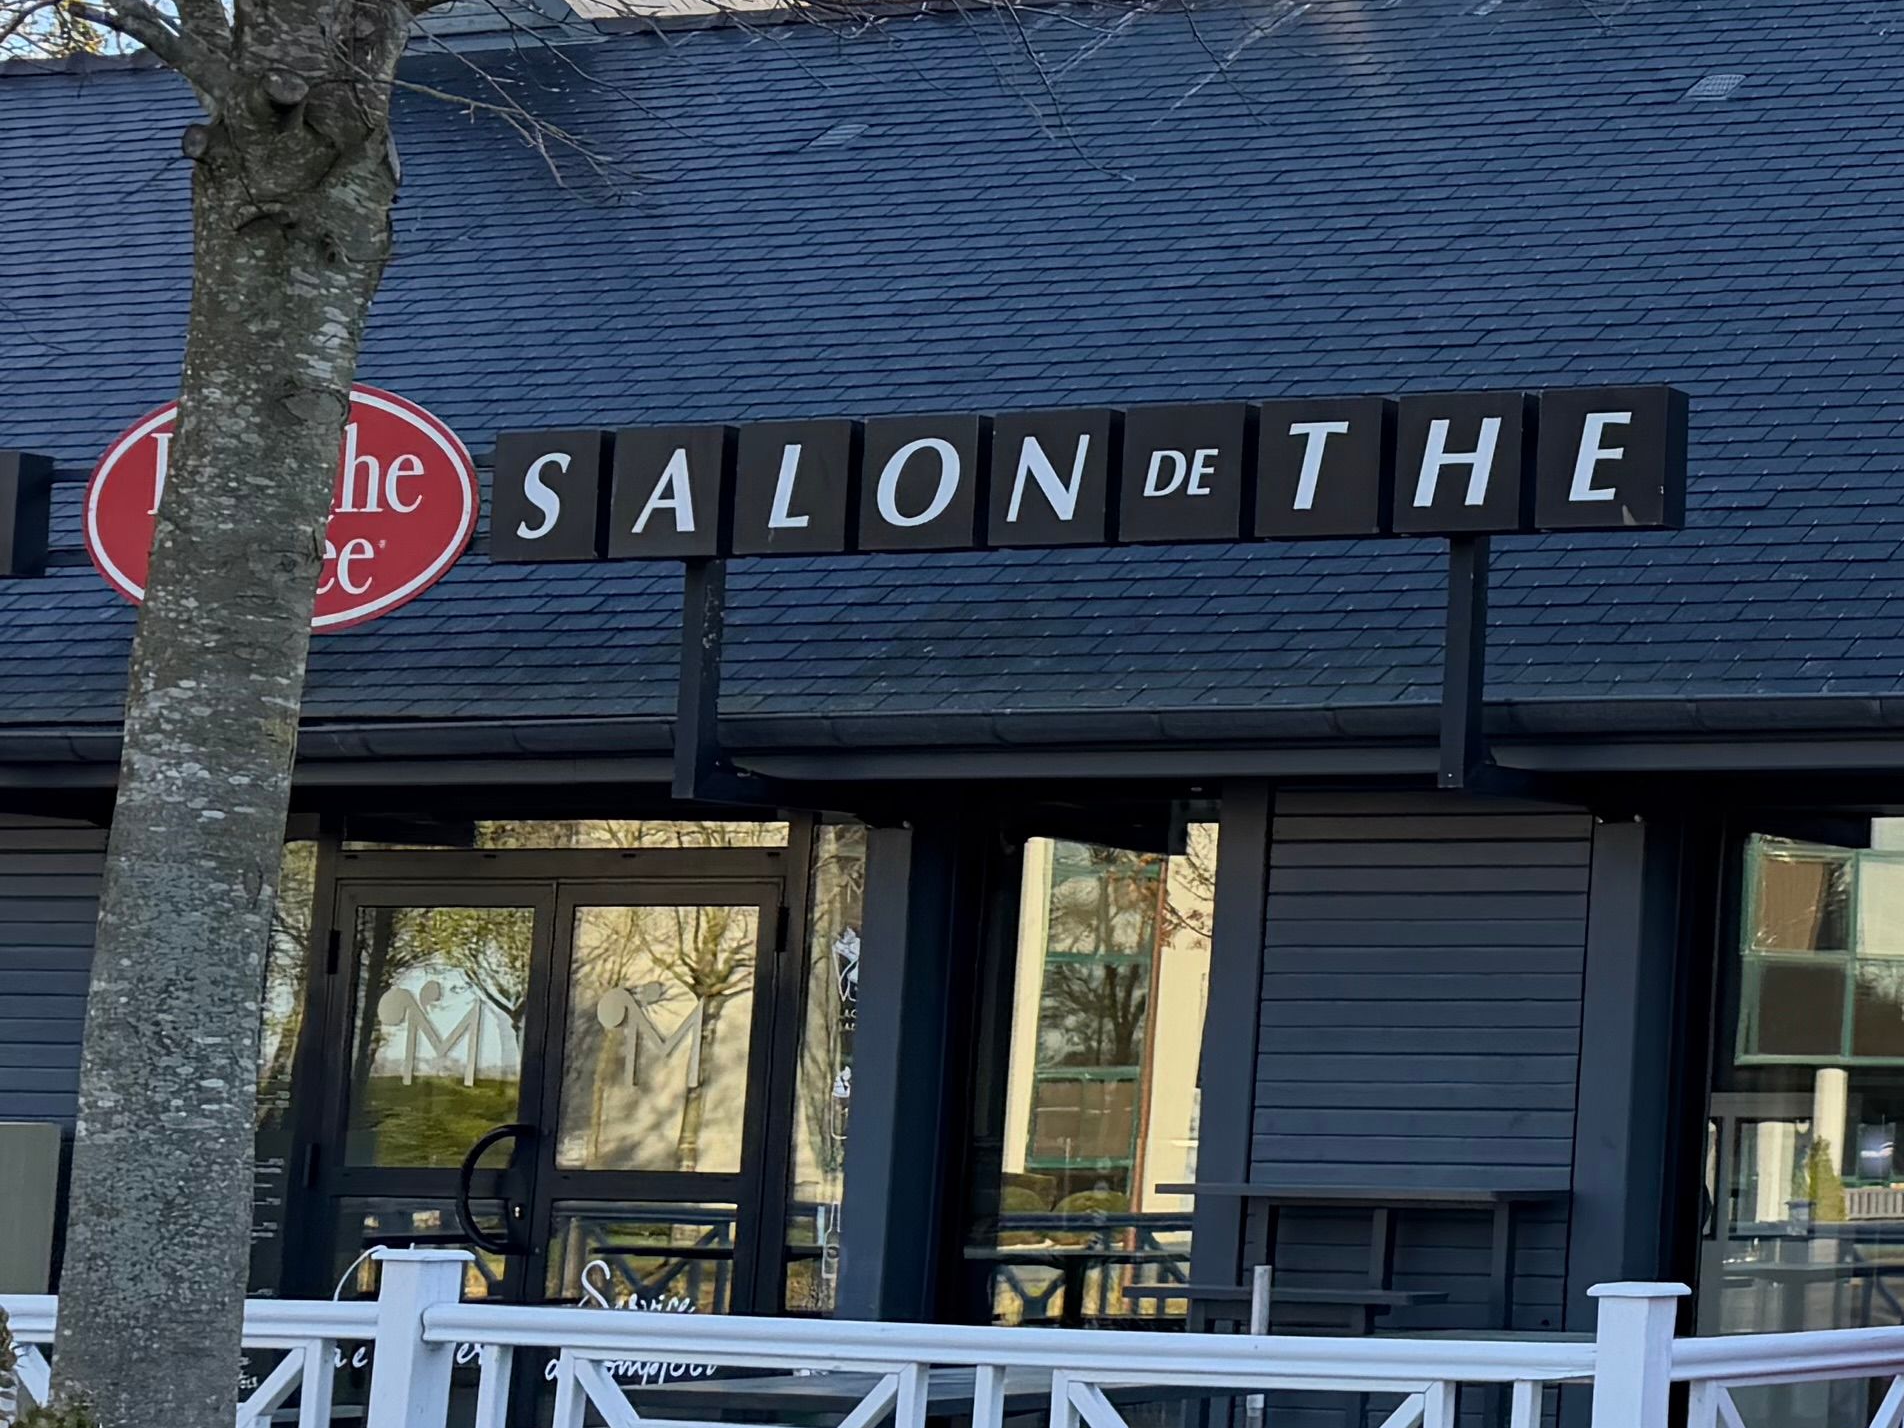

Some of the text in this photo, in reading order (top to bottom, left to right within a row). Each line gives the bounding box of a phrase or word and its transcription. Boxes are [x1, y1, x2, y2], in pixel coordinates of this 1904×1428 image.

[516, 432, 1091, 540] SALON
[1143, 447, 1219, 498] DE
[1287, 410, 1633, 511] THE
